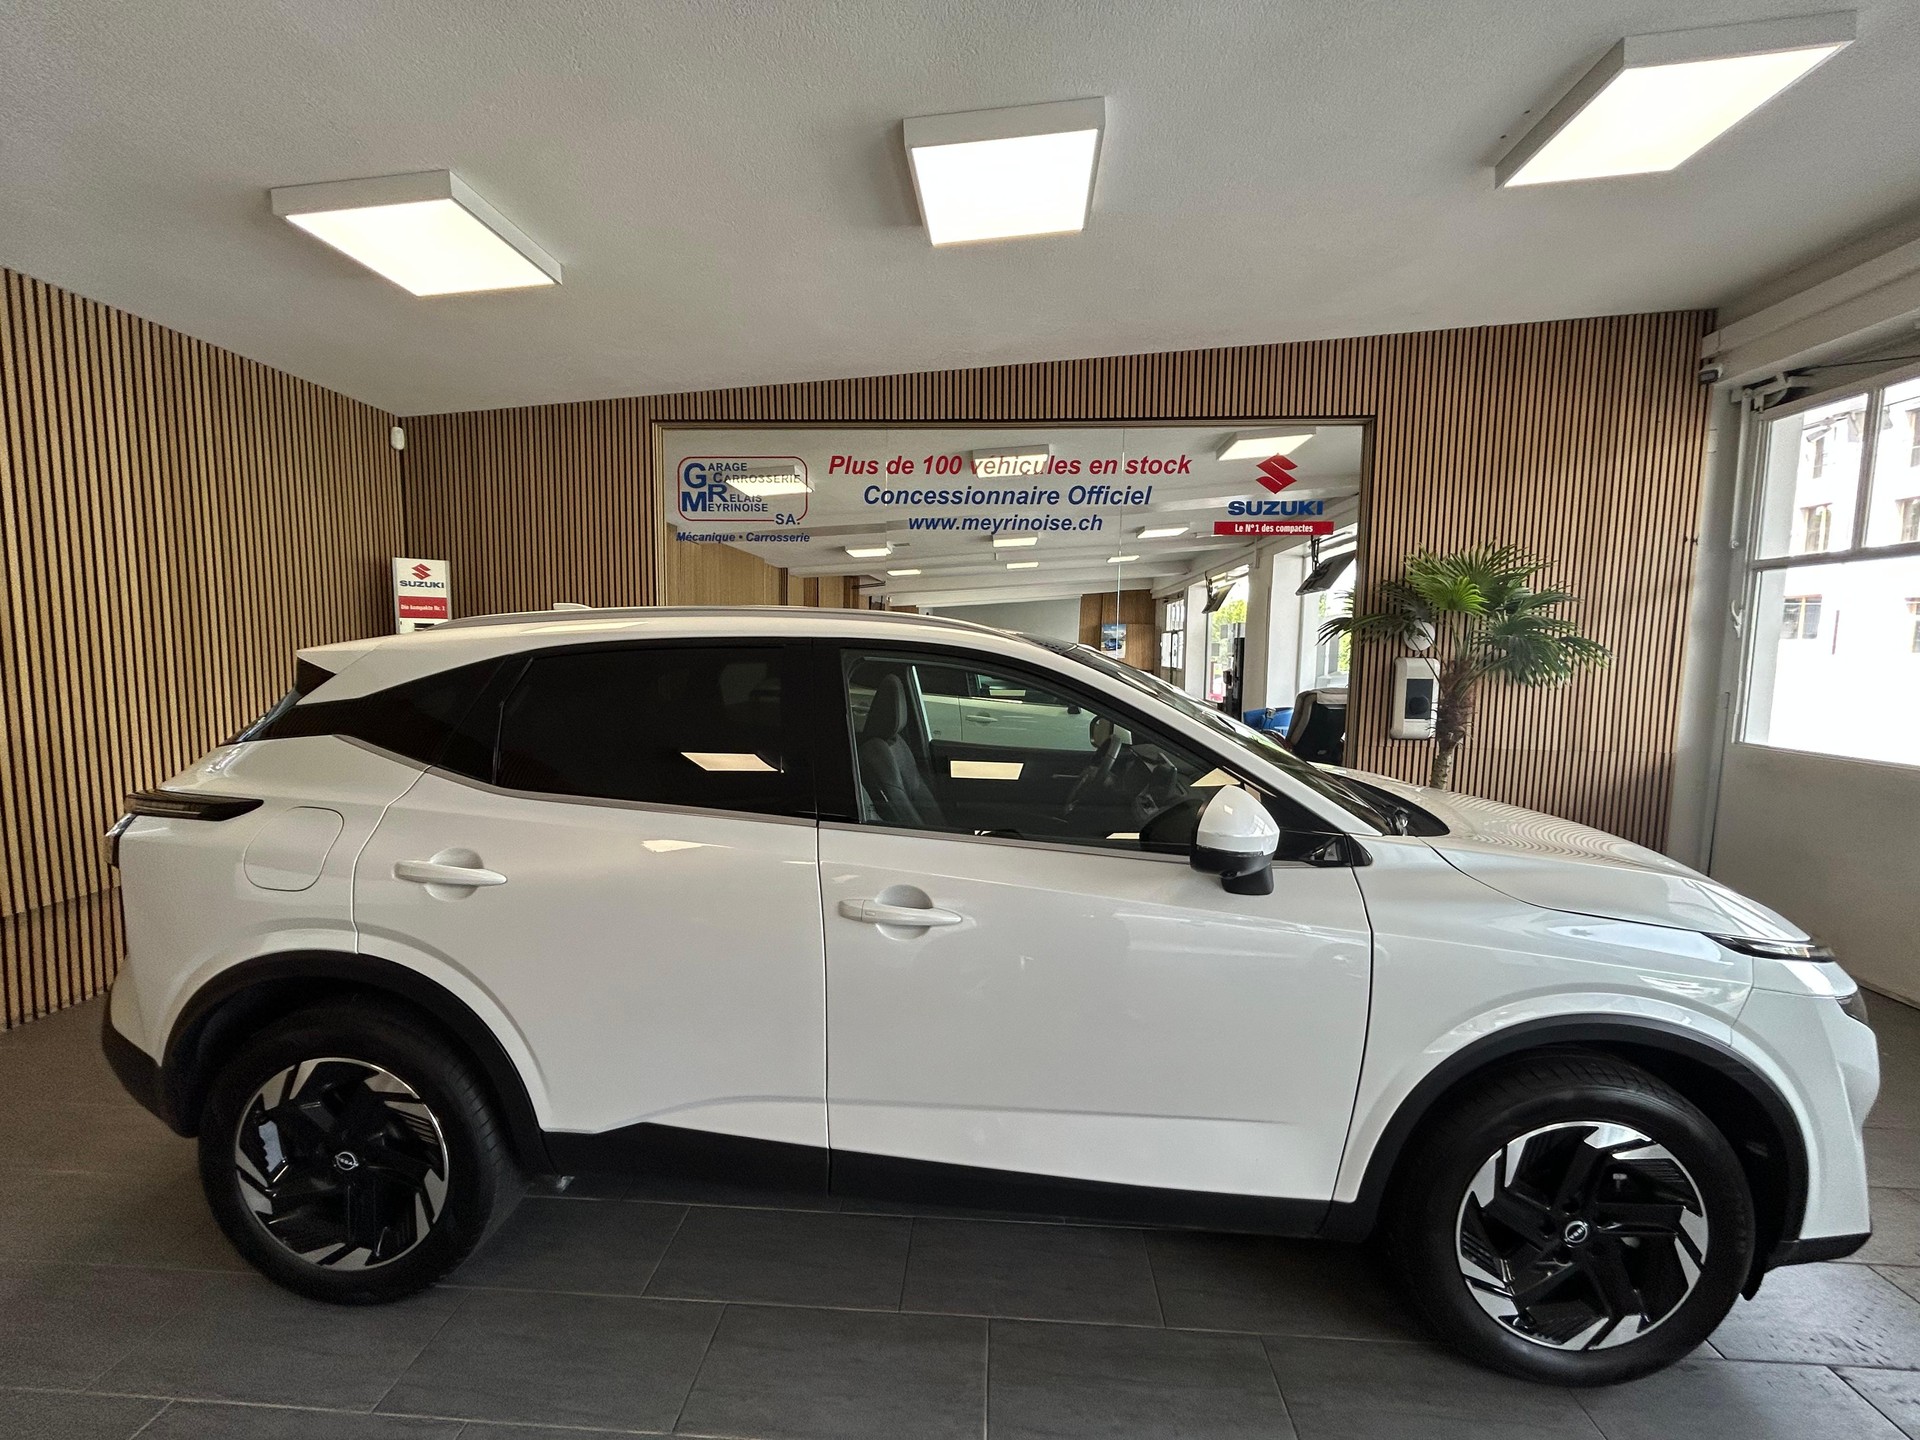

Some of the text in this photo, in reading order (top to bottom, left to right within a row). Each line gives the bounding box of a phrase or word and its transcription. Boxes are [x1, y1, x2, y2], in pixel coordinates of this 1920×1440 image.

[828, 454, 1193, 475] Plus de 100 véhicules en stock
[713, 472, 800, 484] CARROSSERIE
[708, 484, 763, 503] RELAIS
[864, 485, 1152, 506] Concessionnaire Officiel
[681, 491, 769, 512] MEYRINOISE
[1228, 501, 1323, 515] SUZUKI
[775, 514, 800, 525] SA.
[908, 514, 1103, 535] www.meyrinoise.ch
[1235, 524, 1243, 533] Le
[1261, 524, 1274, 533] des
[1276, 524, 1313, 533] compactes
[676, 532, 810, 543] Mécanique Carrosserie
[400, 580, 444, 588] SUZUKI
